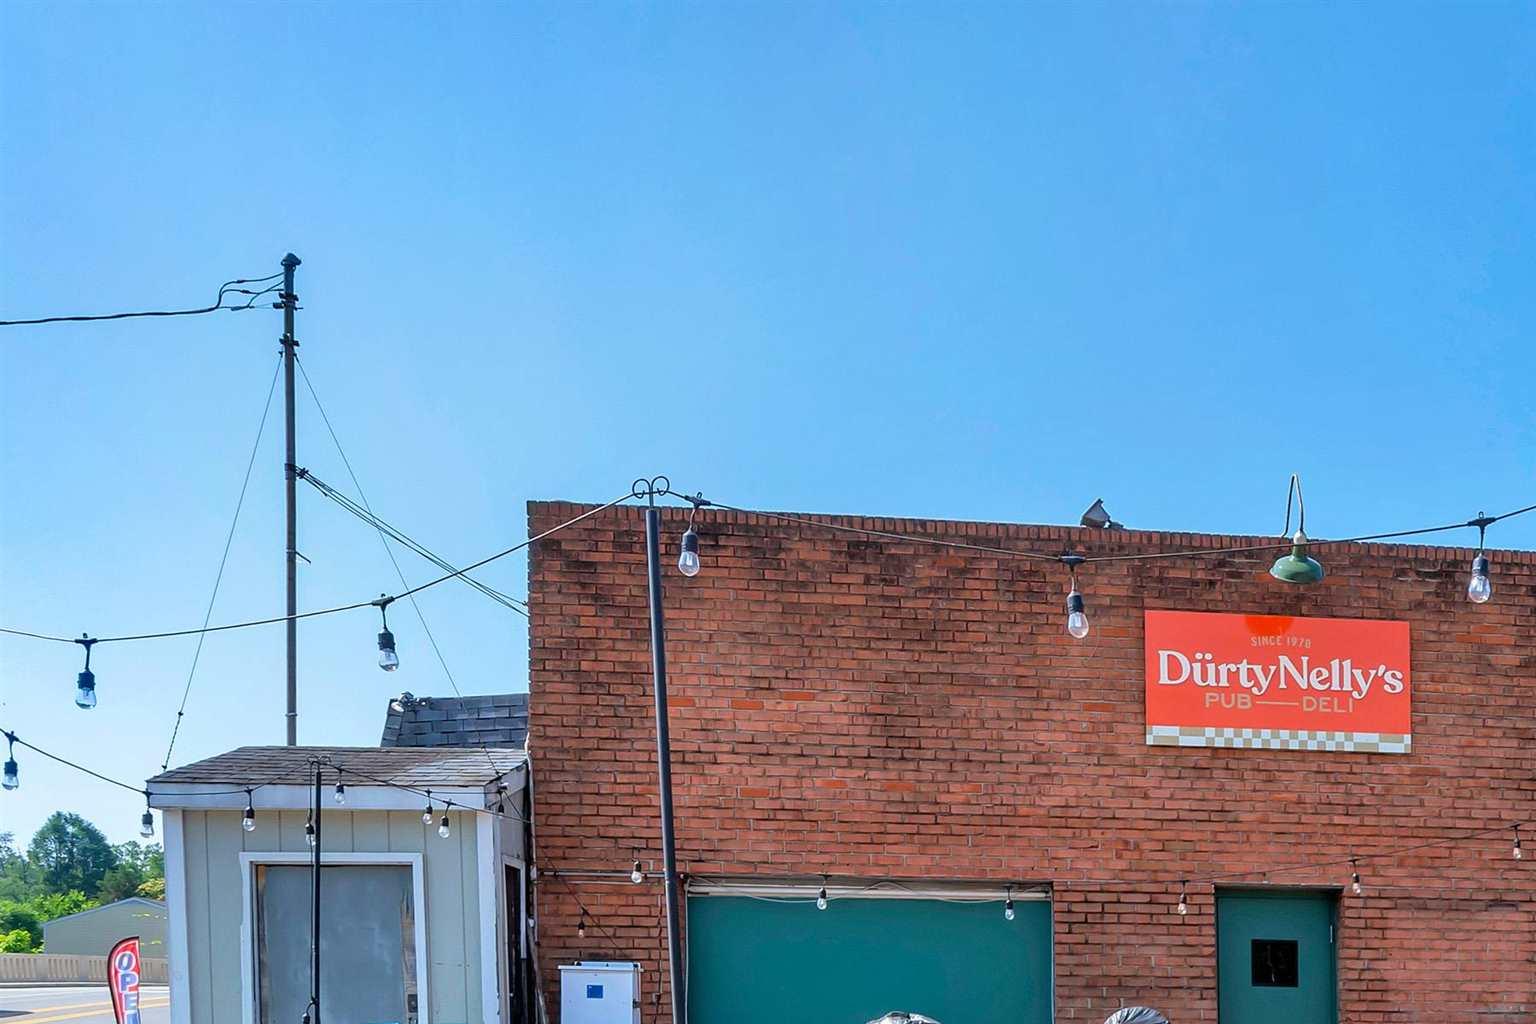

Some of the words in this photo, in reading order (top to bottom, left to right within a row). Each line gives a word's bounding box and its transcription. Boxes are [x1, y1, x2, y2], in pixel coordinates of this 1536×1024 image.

[1250, 635, 1282, 648] SINCE
[1204, 692, 1252, 710] PUB
[1302, 695, 1354, 713] DELI
